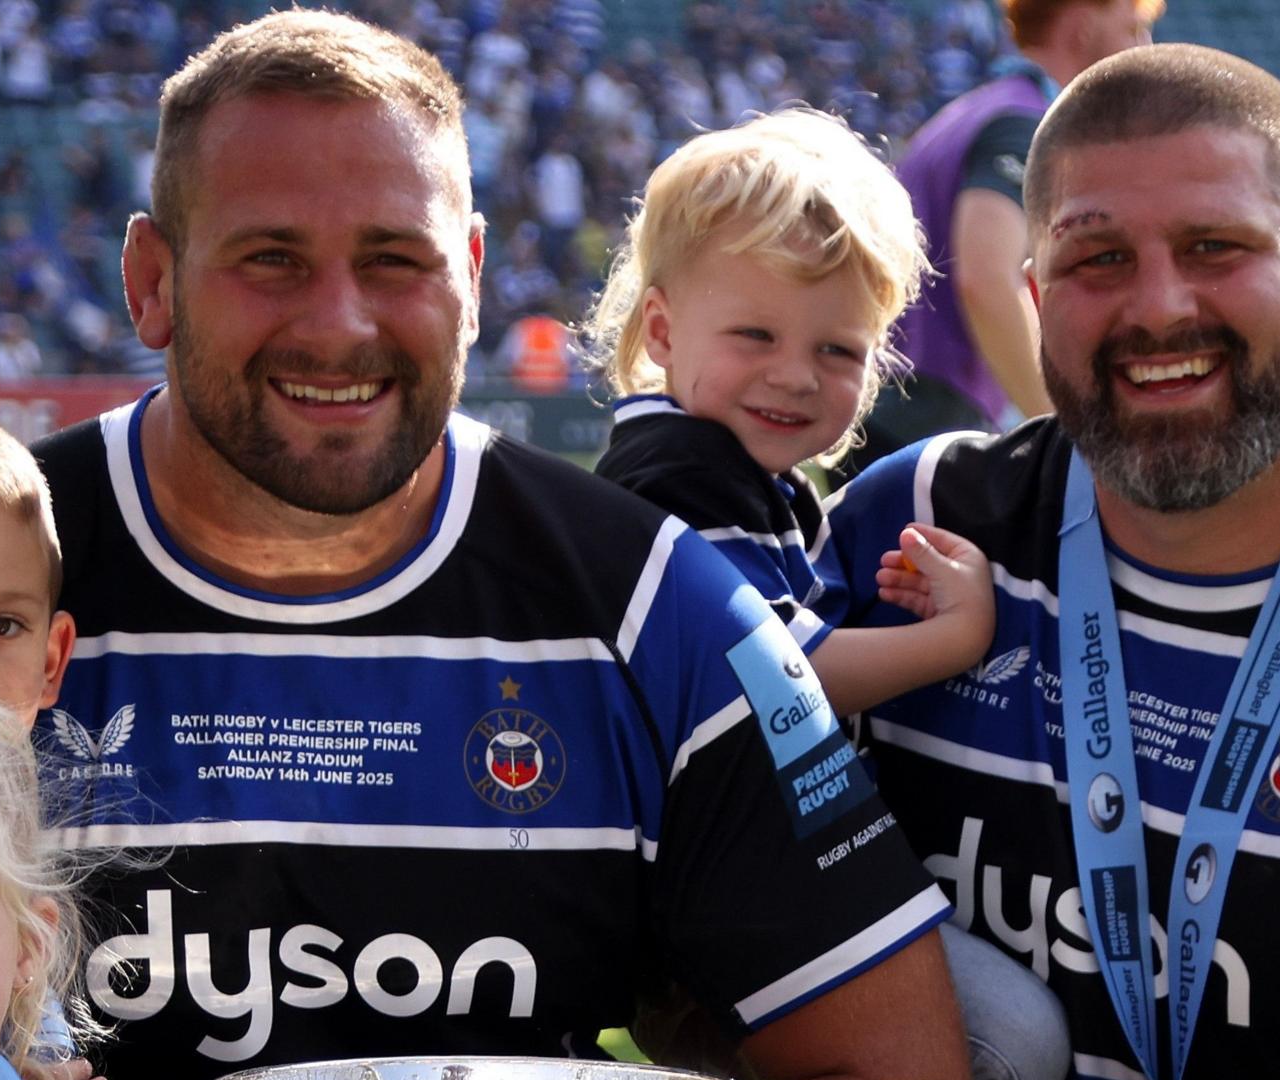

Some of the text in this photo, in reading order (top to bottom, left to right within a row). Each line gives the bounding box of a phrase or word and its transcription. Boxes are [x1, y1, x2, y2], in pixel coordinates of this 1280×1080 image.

[1080, 611, 1113, 760] Gallagher
[1128, 690, 1188, 719] EICESTER
[1192, 709, 1221, 725] TIGE
[171, 714, 209, 727] BATH
[214, 715, 266, 729] RUGBY
[284, 718, 364, 733] LEICESTER
[368, 721, 422, 735] TIGERS
[477, 711, 548, 742] BATH
[1188, 726, 1215, 741] FIN
[174, 732, 418, 752] GALLAGHER PREMIERSHIP FINAL
[227, 749, 364, 767] ALLIANZ STADIUM
[1163, 753, 1196, 772] 2025
[1222, 728, 1259, 809] PREMIERSHIP
[198, 766, 394, 785] SATURDAY 14th JUNE 2025
[476, 774, 556, 812] RUGBY
[509, 828, 529, 849] 50
[816, 840, 852, 870] RUGBY
[1102, 870, 1119, 955] PREMIERSHIP
[1117, 911, 1130, 956] RUGBY
[86, 889, 537, 1062] dyson
